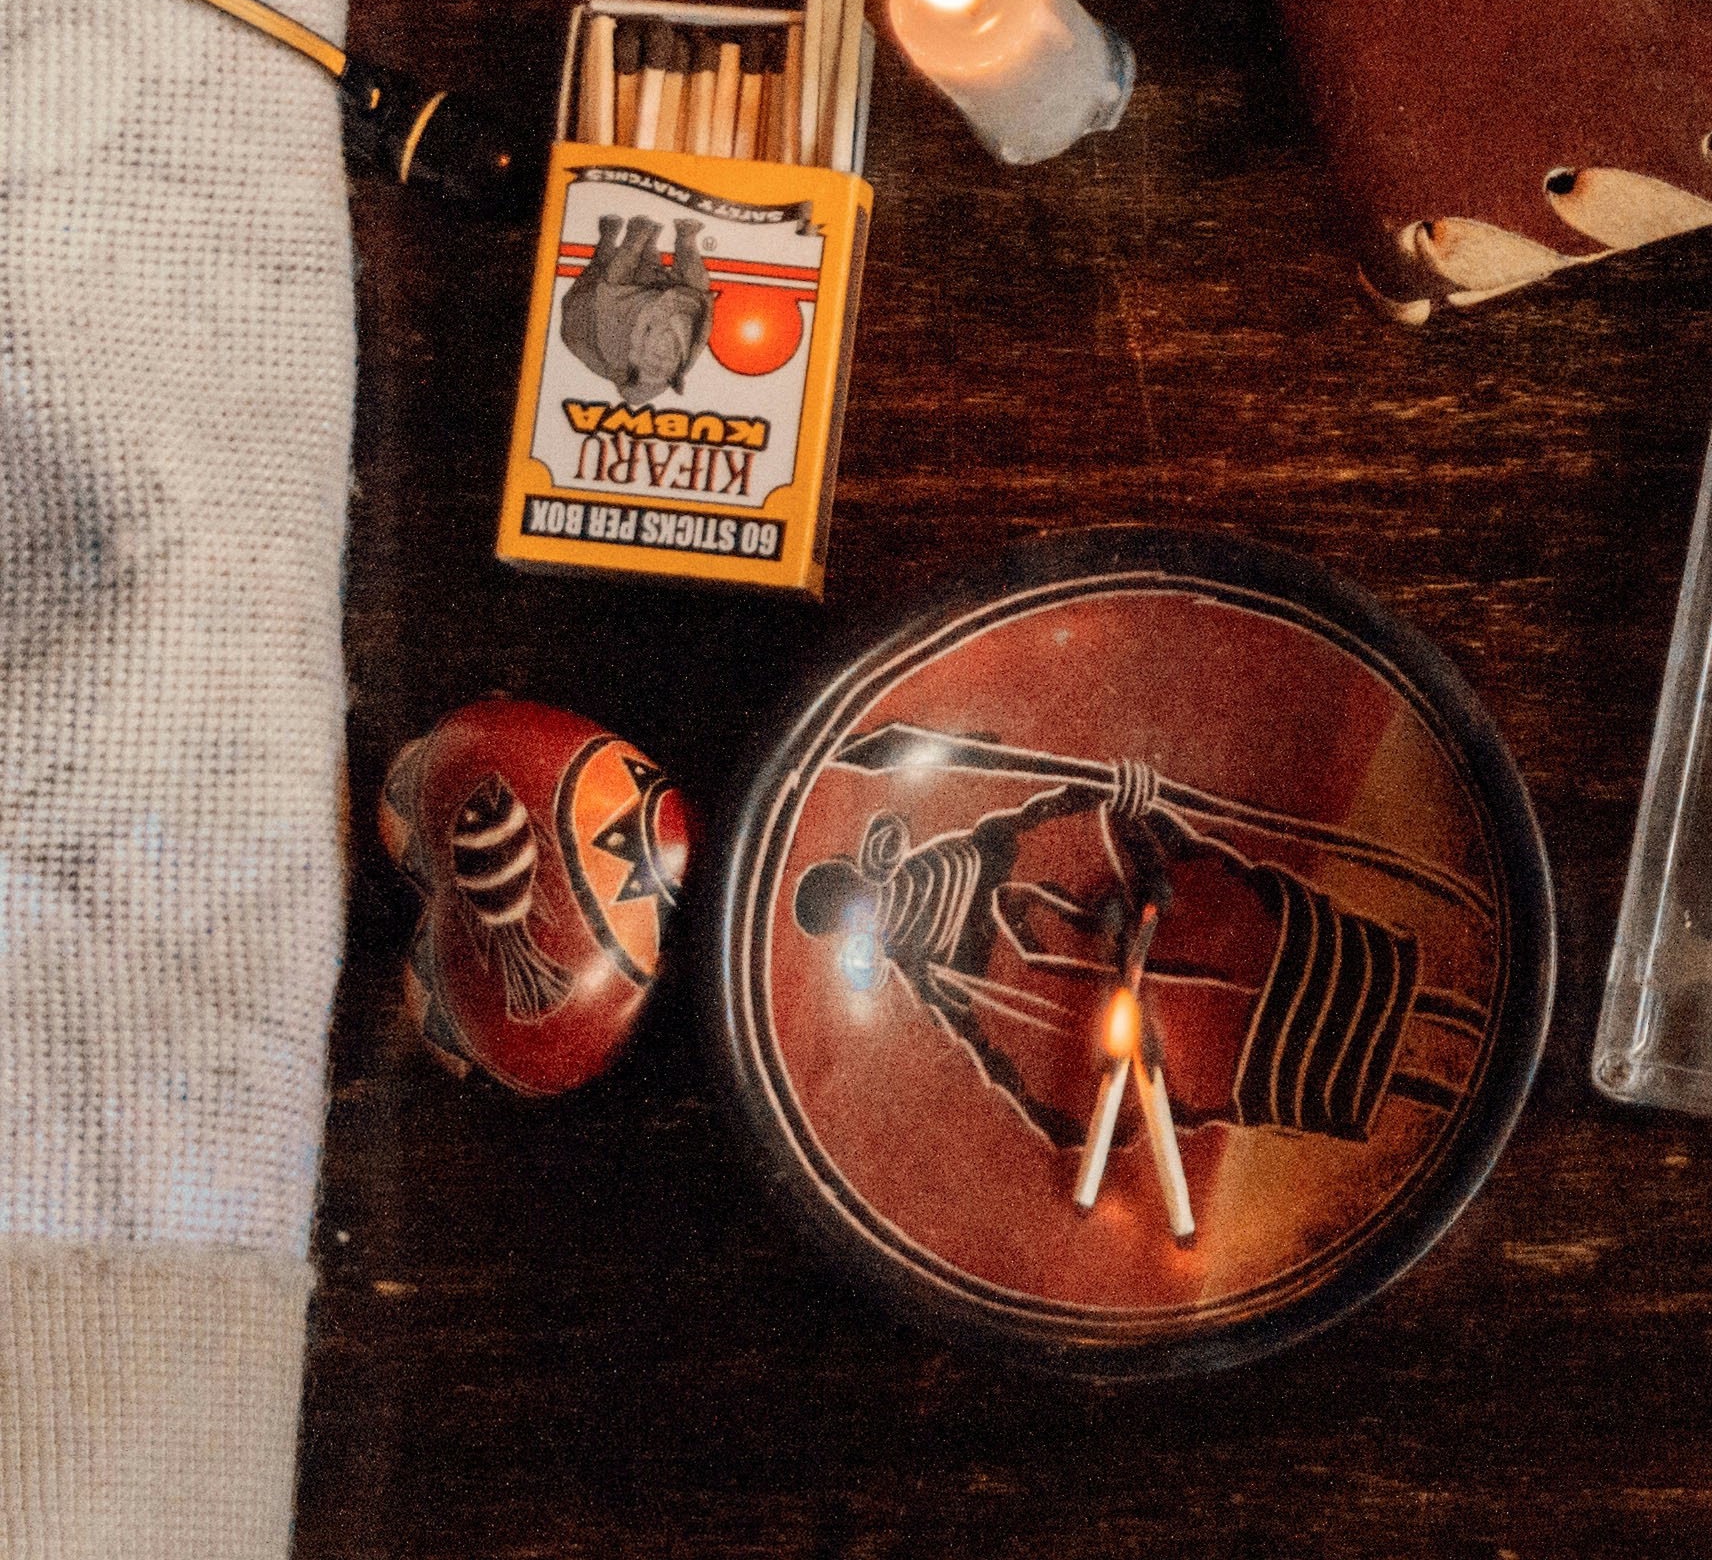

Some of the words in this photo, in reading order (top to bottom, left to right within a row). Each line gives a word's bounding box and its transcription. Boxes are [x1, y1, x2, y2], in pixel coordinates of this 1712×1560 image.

[585, 167, 692, 205] MATCHES
[698, 192, 785, 223] SAFETY
[562, 400, 771, 451] KUBWA
[576, 433, 756, 497] KIFARU
[531, 502, 583, 537] BOX
[589, 507, 637, 541] PER
[642, 513, 733, 552] STICKS
[735, 520, 779, 557] 60
